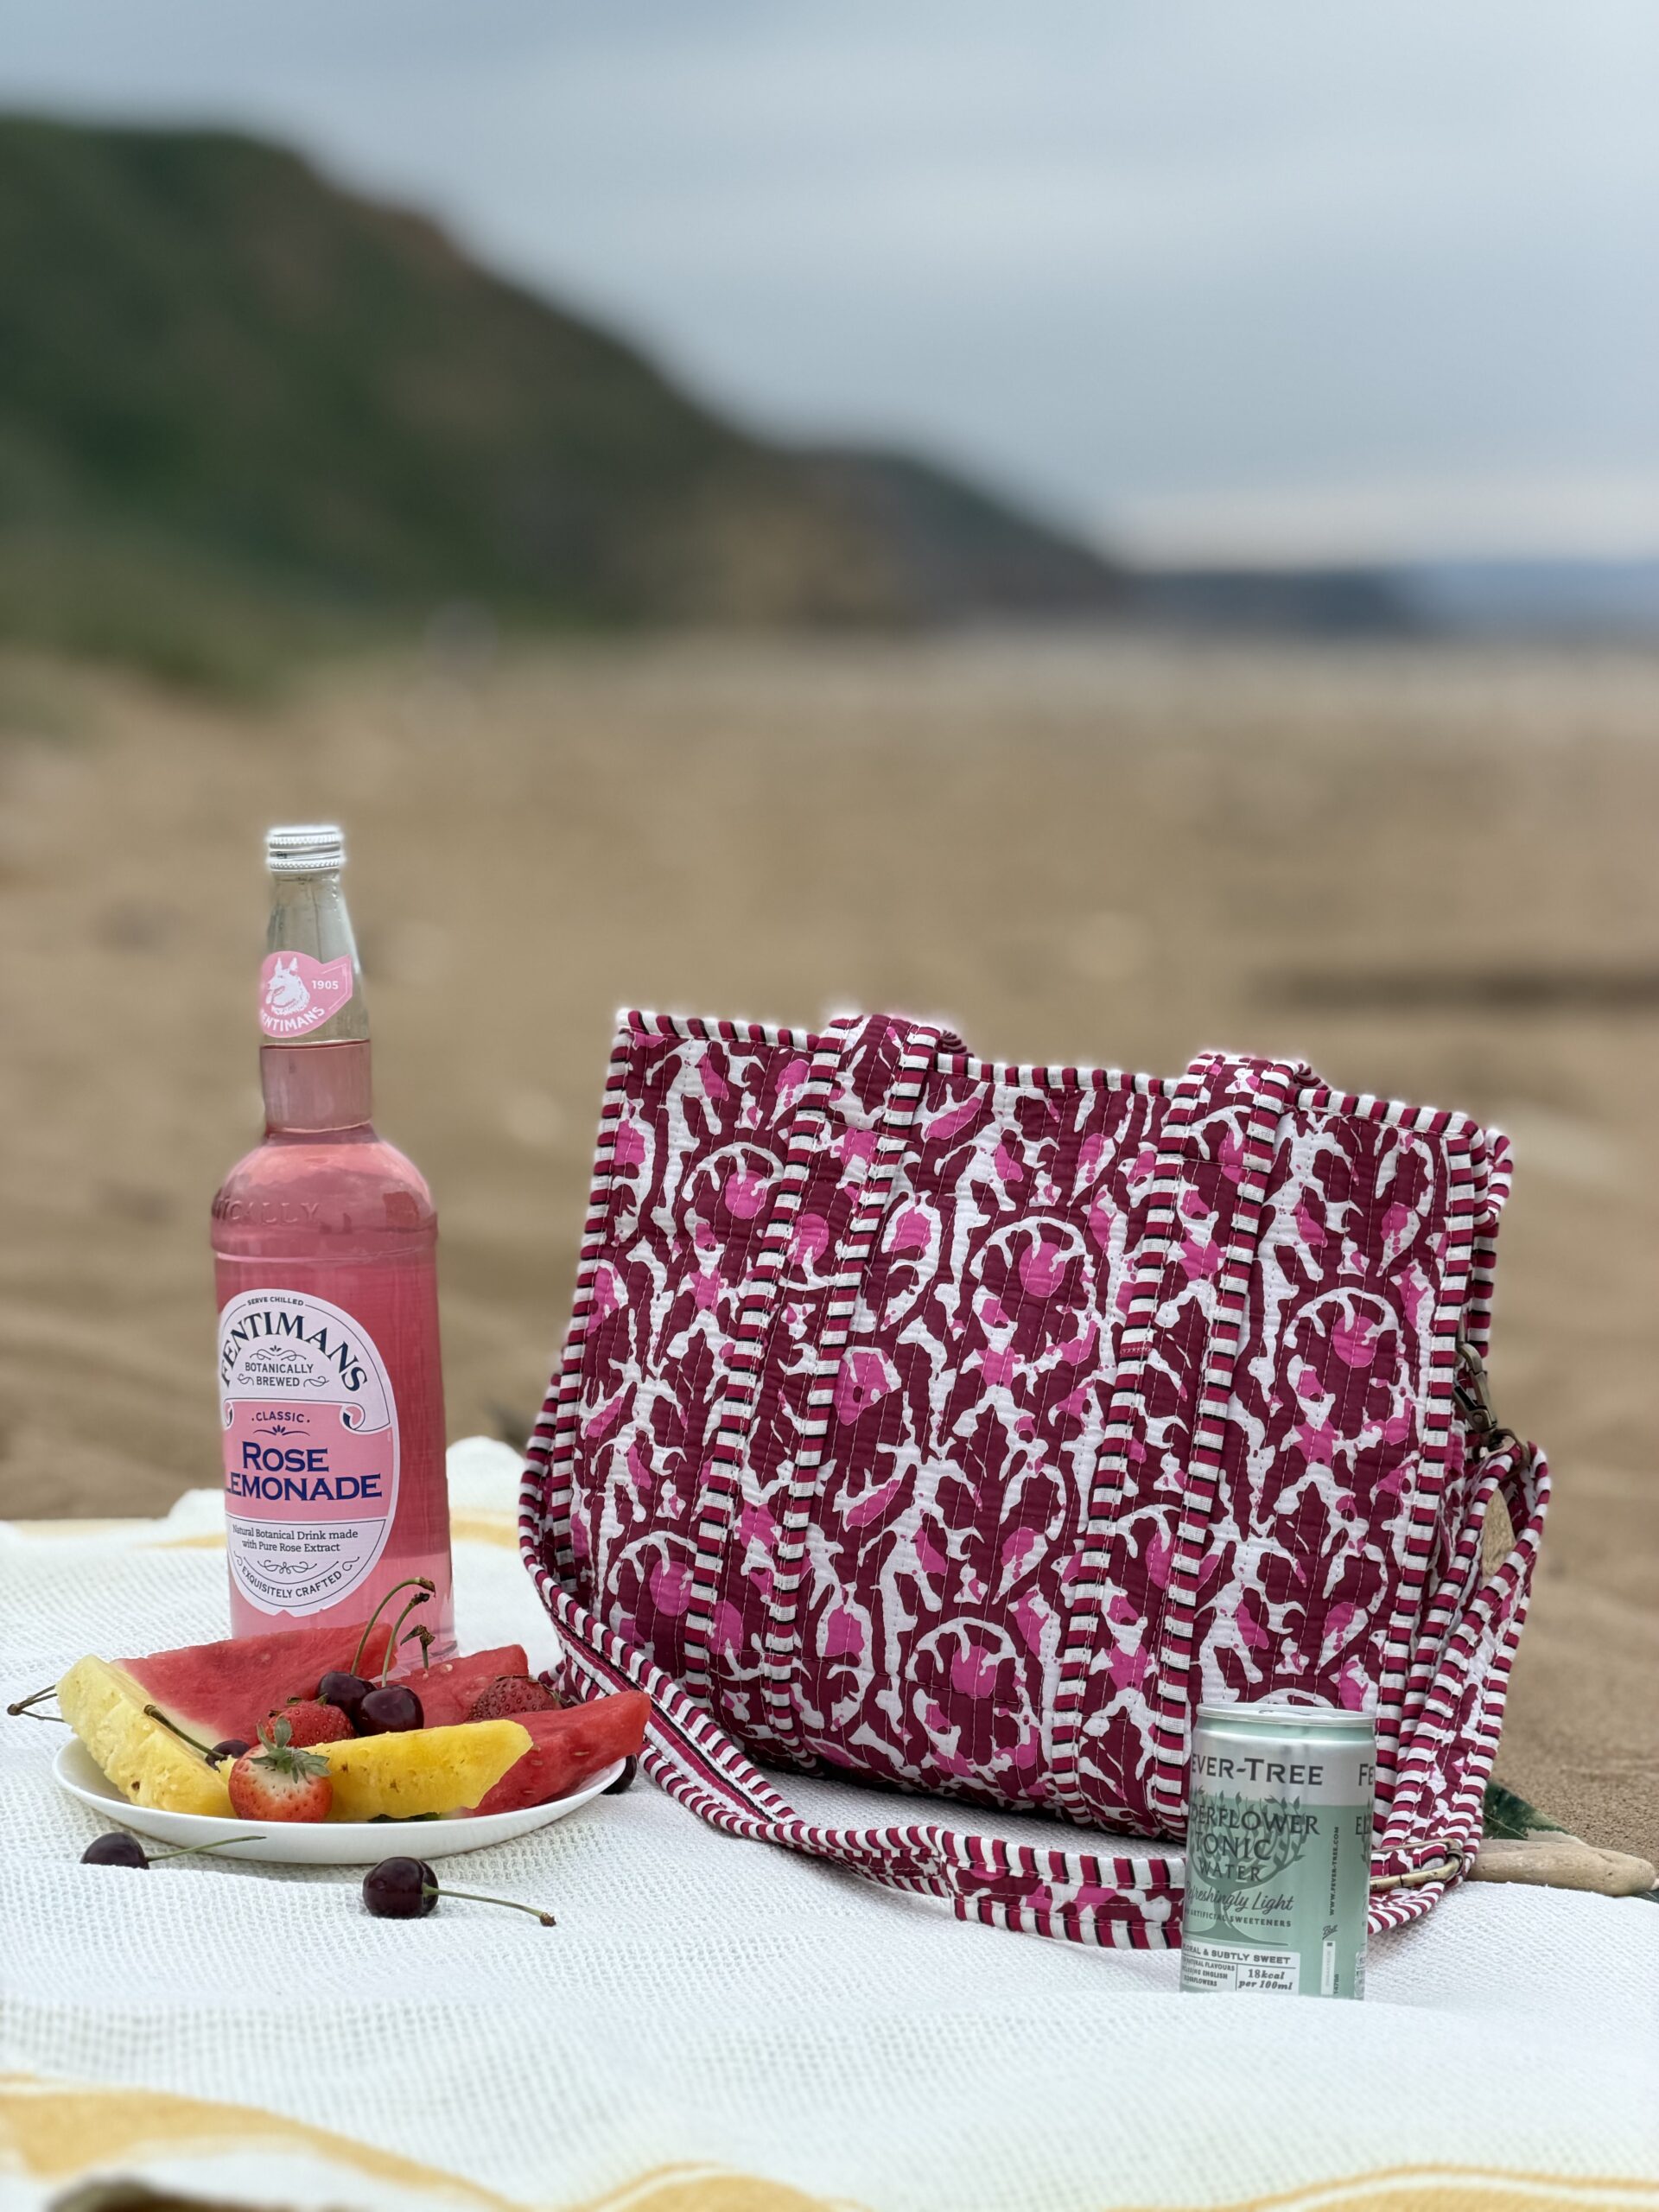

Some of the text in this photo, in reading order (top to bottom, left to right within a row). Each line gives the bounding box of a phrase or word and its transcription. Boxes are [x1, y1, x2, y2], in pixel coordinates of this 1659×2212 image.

[312, 980, 339, 990] 1905
[261, 1006, 325, 1032] ENTIMANS
[247, 1296, 304, 1306] SERVE CHILLED
[221, 1312, 368, 1392] FENTIMANS
[245, 1362, 314, 1374] BOTANICALLY
[256, 1376, 300, 1387] BREWED
[256, 1411, 304, 1423] CLASSIC
[242, 1441, 329, 1472] ROSE
[232, 1524, 359, 1540] Natural Botanical Drink made
[242, 1539, 340, 1553] with Pure Rose Extract
[242, 1567, 342, 1599] EXQUISITELY CRAFTED
[1196, 1831, 1273, 1861] TONIC
[1199, 1855, 1264, 1882] WATER
[1329, 1827, 1339, 1916] WWW.FEVER-TREE.COM
[1251, 1891, 1295, 1915] Light
[1191, 1910, 1227, 1922] ARTIFICIAL
[1230, 1916, 1292, 1928] SWEETENERS
[1203, 1948, 1209, 1956] &
[1211, 1949, 1251, 1961] SUBTLY
[1253, 1955, 1291, 1964] SWEET
[1205, 1961, 1235, 1971] FLAVOURS
[1248, 1969, 1285, 1980] 18kcal
[1238, 1980, 1293, 1991] per 100ml
